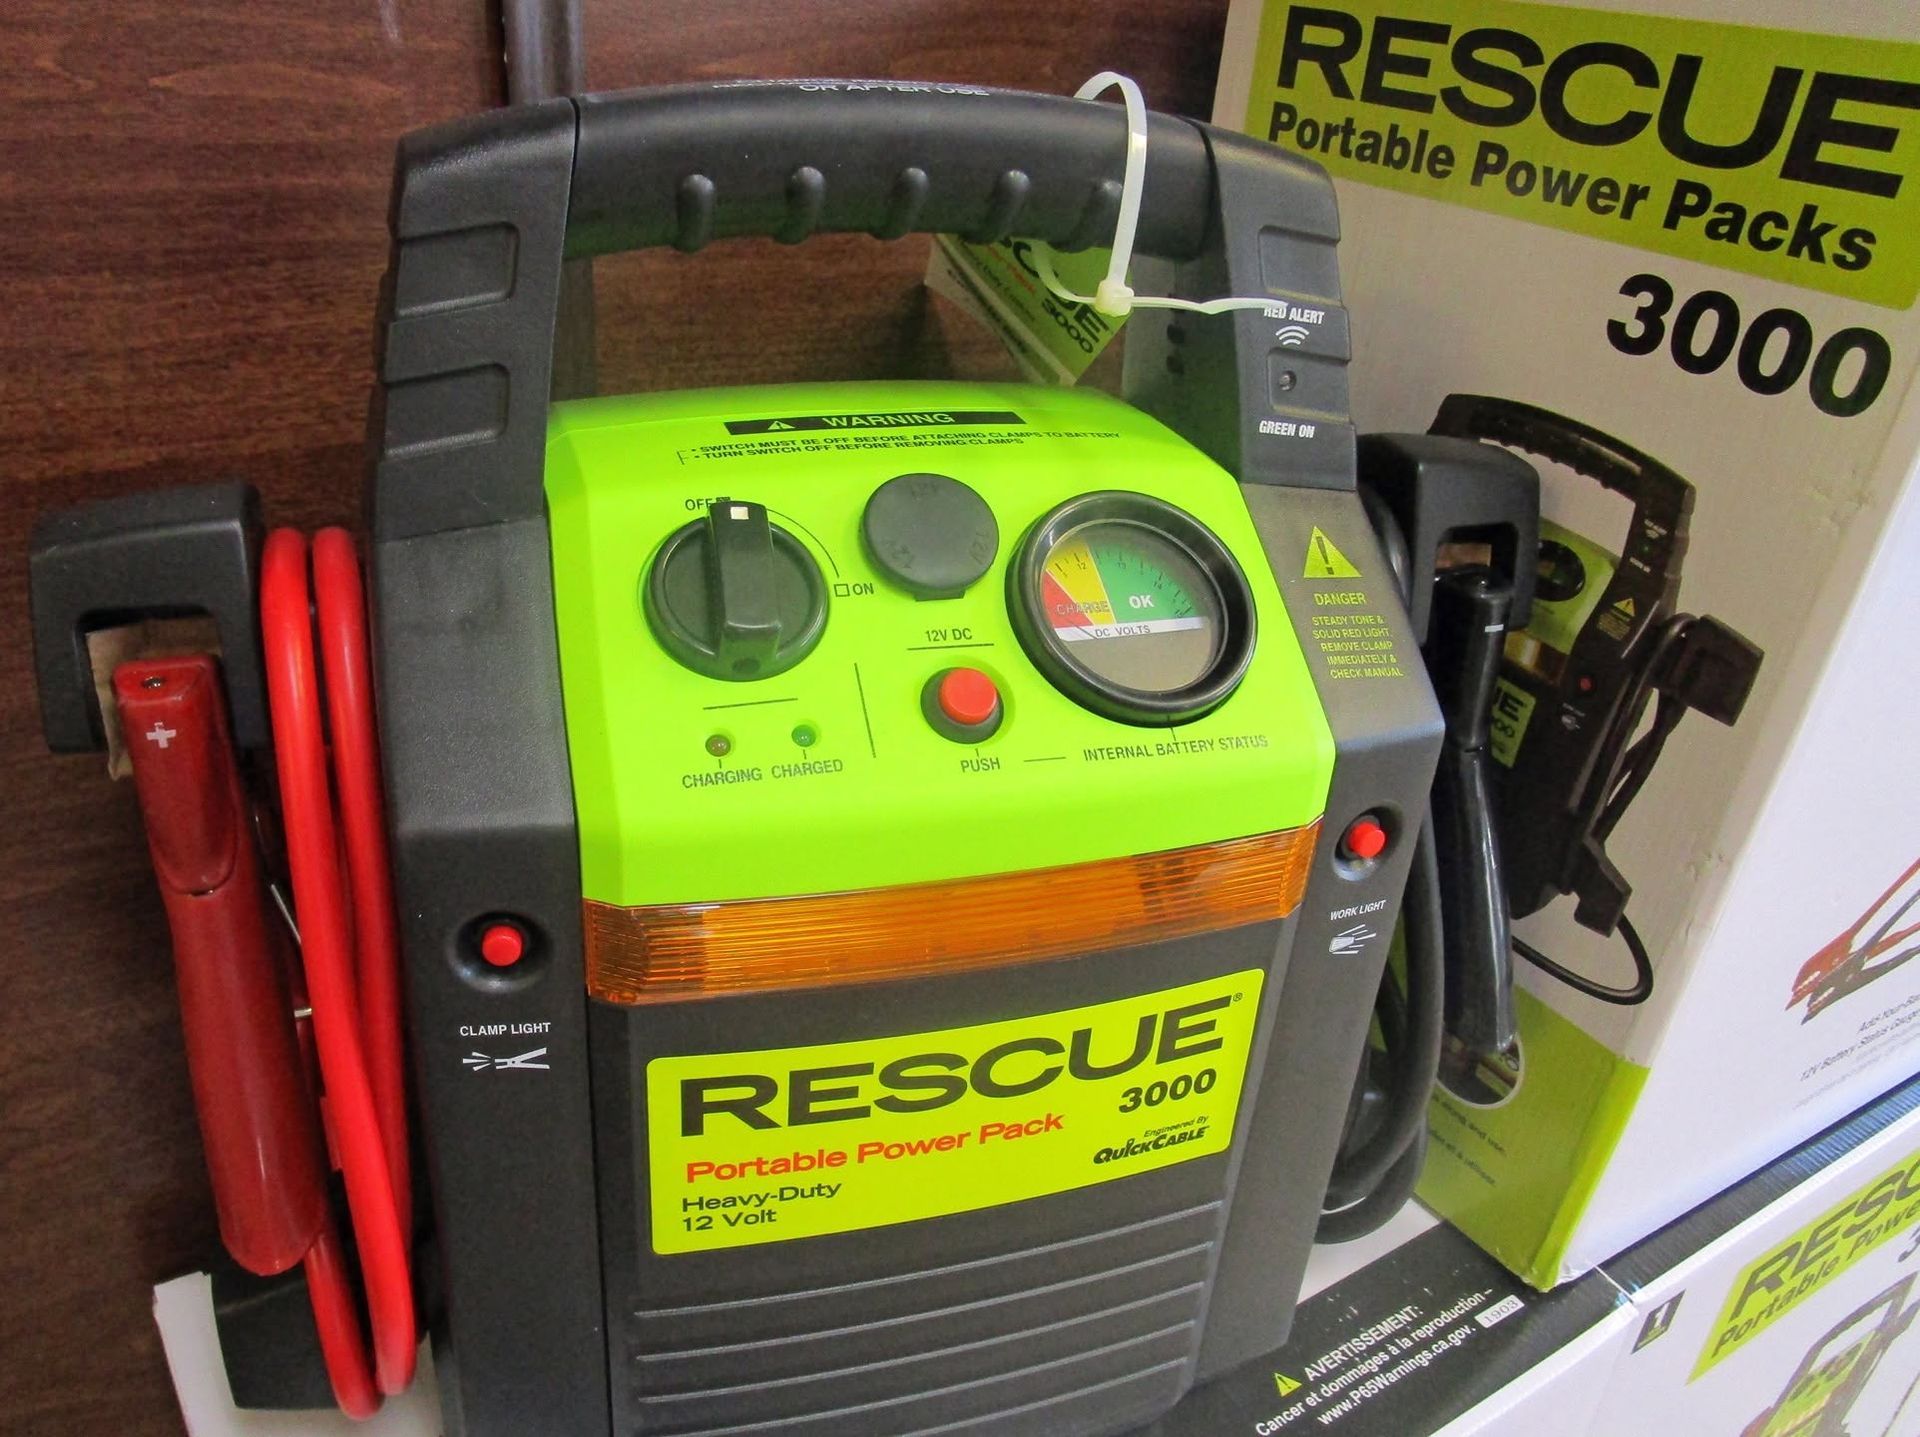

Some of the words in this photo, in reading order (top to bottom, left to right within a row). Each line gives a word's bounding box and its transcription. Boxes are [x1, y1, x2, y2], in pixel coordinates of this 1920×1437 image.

[1277, 5, 1920, 199] RESCUE
[1269, 101, 1455, 179] Portable
[1470, 141, 1650, 220] Power
[1663, 178, 1877, 271] Packs
[1263, 306, 1287, 318] RED
[1288, 307, 1325, 324] ALERT
[1606, 274, 1892, 418] 3000
[822, 413, 956, 427] WARNING
[1258, 420, 1296, 437] GREEN
[1298, 424, 1315, 439] ON
[700, 442, 755, 453] SWITCH
[758, 440, 797, 448] MUST
[854, 434, 909, 442] BEFORE
[912, 432, 987, 441] ATTACHING
[1062, 431, 1120, 439] BATTERY
[704, 451, 743, 459] TURN
[749, 446, 801, 456] SWITCH
[805, 444, 835, 452] OFF
[839, 441, 889, 450] BEFORE
[893, 438, 966, 448] REMOVING
[969, 437, 1024, 446] CLAMPS
[685, 497, 711, 511] OFF
[852, 582, 875, 596] ON
[1314, 592, 1368, 606] DANGER
[1056, 601, 1109, 615] CHARGE
[1128, 594, 1154, 609] OK
[1094, 628, 1111, 638] DC
[1115, 625, 1151, 636] VOLTS
[1312, 615, 1349, 626] STEADY
[1351, 615, 1375, 625] TONE
[1376, 615, 1384, 625] &
[925, 629, 948, 643] 12V
[950, 628, 973, 642] DC
[1312, 629, 1342, 640] SOLID
[1343, 628, 1362, 639] RED
[1363, 627, 1390, 638] LIGHT
[1320, 642, 1359, 653] REMOVE
[1361, 641, 1393, 651] CLAMP
[1326, 654, 1388, 666] IMMEDIATELY
[1389, 654, 1397, 664] &
[1330, 668, 1362, 679] CHECK
[1364, 667, 1404, 677] MANUAL
[1083, 744, 1154, 762] INTERNAL
[1155, 739, 1215, 756] BATTERY
[1218, 734, 1268, 751] STATUS
[682, 767, 762, 790] CHARGING
[771, 758, 844, 780] CHARGED
[960, 757, 1001, 774] PUSH
[1330, 906, 1358, 921] WORK
[1359, 899, 1387, 914] LIGHT
[459, 1024, 507, 1037] CLAMP
[510, 1022, 551, 1035] LIGHT
[680, 995, 1232, 1137] RESCUE
[1118, 1068, 1217, 1113] 3000
[1143, 1118, 1196, 1138] Engineered
[1196, 1115, 1209, 1126] By
[686, 1148, 848, 1184] Portable
[857, 1129, 977, 1165] Power
[979, 1112, 1065, 1145] Pack
[682, 1182, 841, 1213] Heavy-Duty
[682, 1214, 714, 1232] 12
[720, 1207, 777, 1228] Volt
[1484, 1299, 1519, 1325] 1903
[1711, 1255, 1841, 1359] Portable
[1304, 1304, 1424, 1382] AVERTISSEMENT:
[1255, 1401, 1306, 1436] Cancer
[1305, 1391, 1323, 1407] et
[1322, 1350, 1389, 1398] dommages
[1388, 1342, 1400, 1357] à
[1397, 1336, 1413, 1351] la
[1411, 1293, 1486, 1342] reproduction
[1317, 1326, 1477, 1426] www.P65Warnings.ca.gov.
